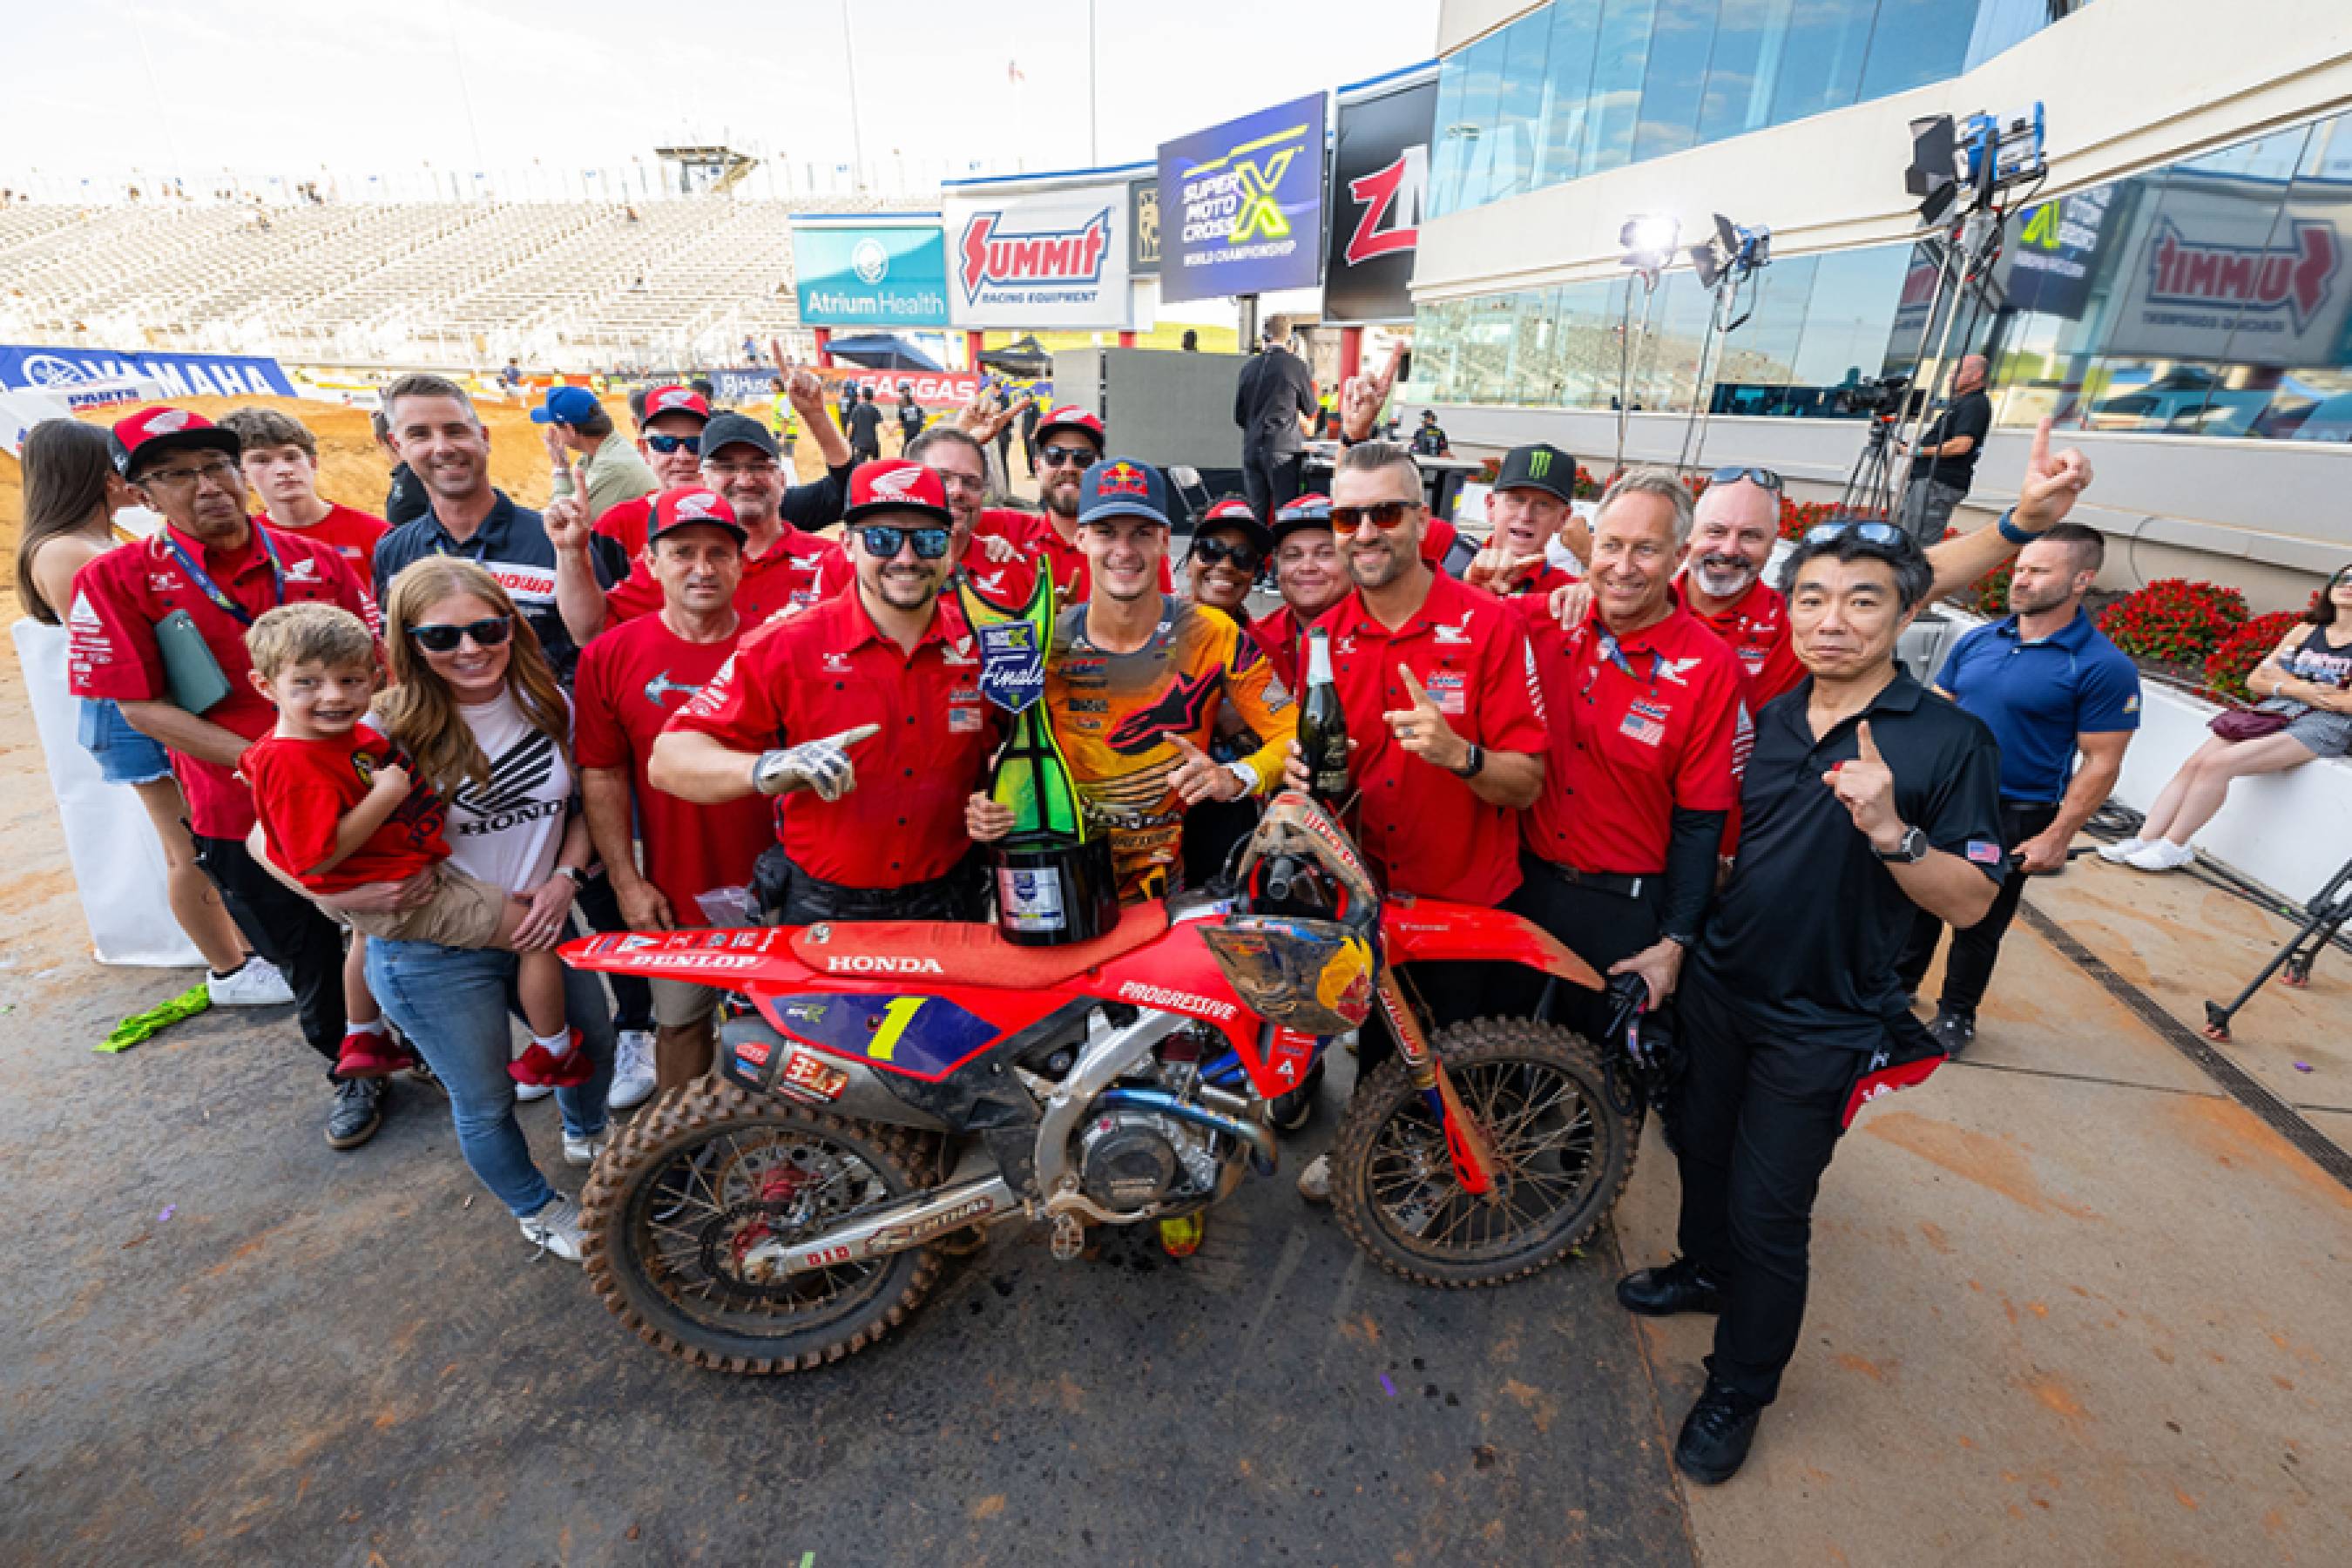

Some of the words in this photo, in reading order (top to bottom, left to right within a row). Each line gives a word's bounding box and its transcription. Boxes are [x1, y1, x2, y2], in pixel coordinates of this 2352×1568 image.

[1183, 173, 1238, 205] SUPER
[1186, 197, 1234, 223] MOTO
[964, 218, 1105, 290] SUMMIT
[808, 288, 875, 315] Atrium
[878, 294, 943, 315] Health
[983, 292, 1025, 303] RACING
[1031, 290, 1097, 302] EQUIPMENT
[459, 798, 563, 836] HOND
[828, 955, 943, 973] HONDA
[1118, 981, 1238, 1020] PROGRESSIVE
[868, 997, 928, 1060] 1
